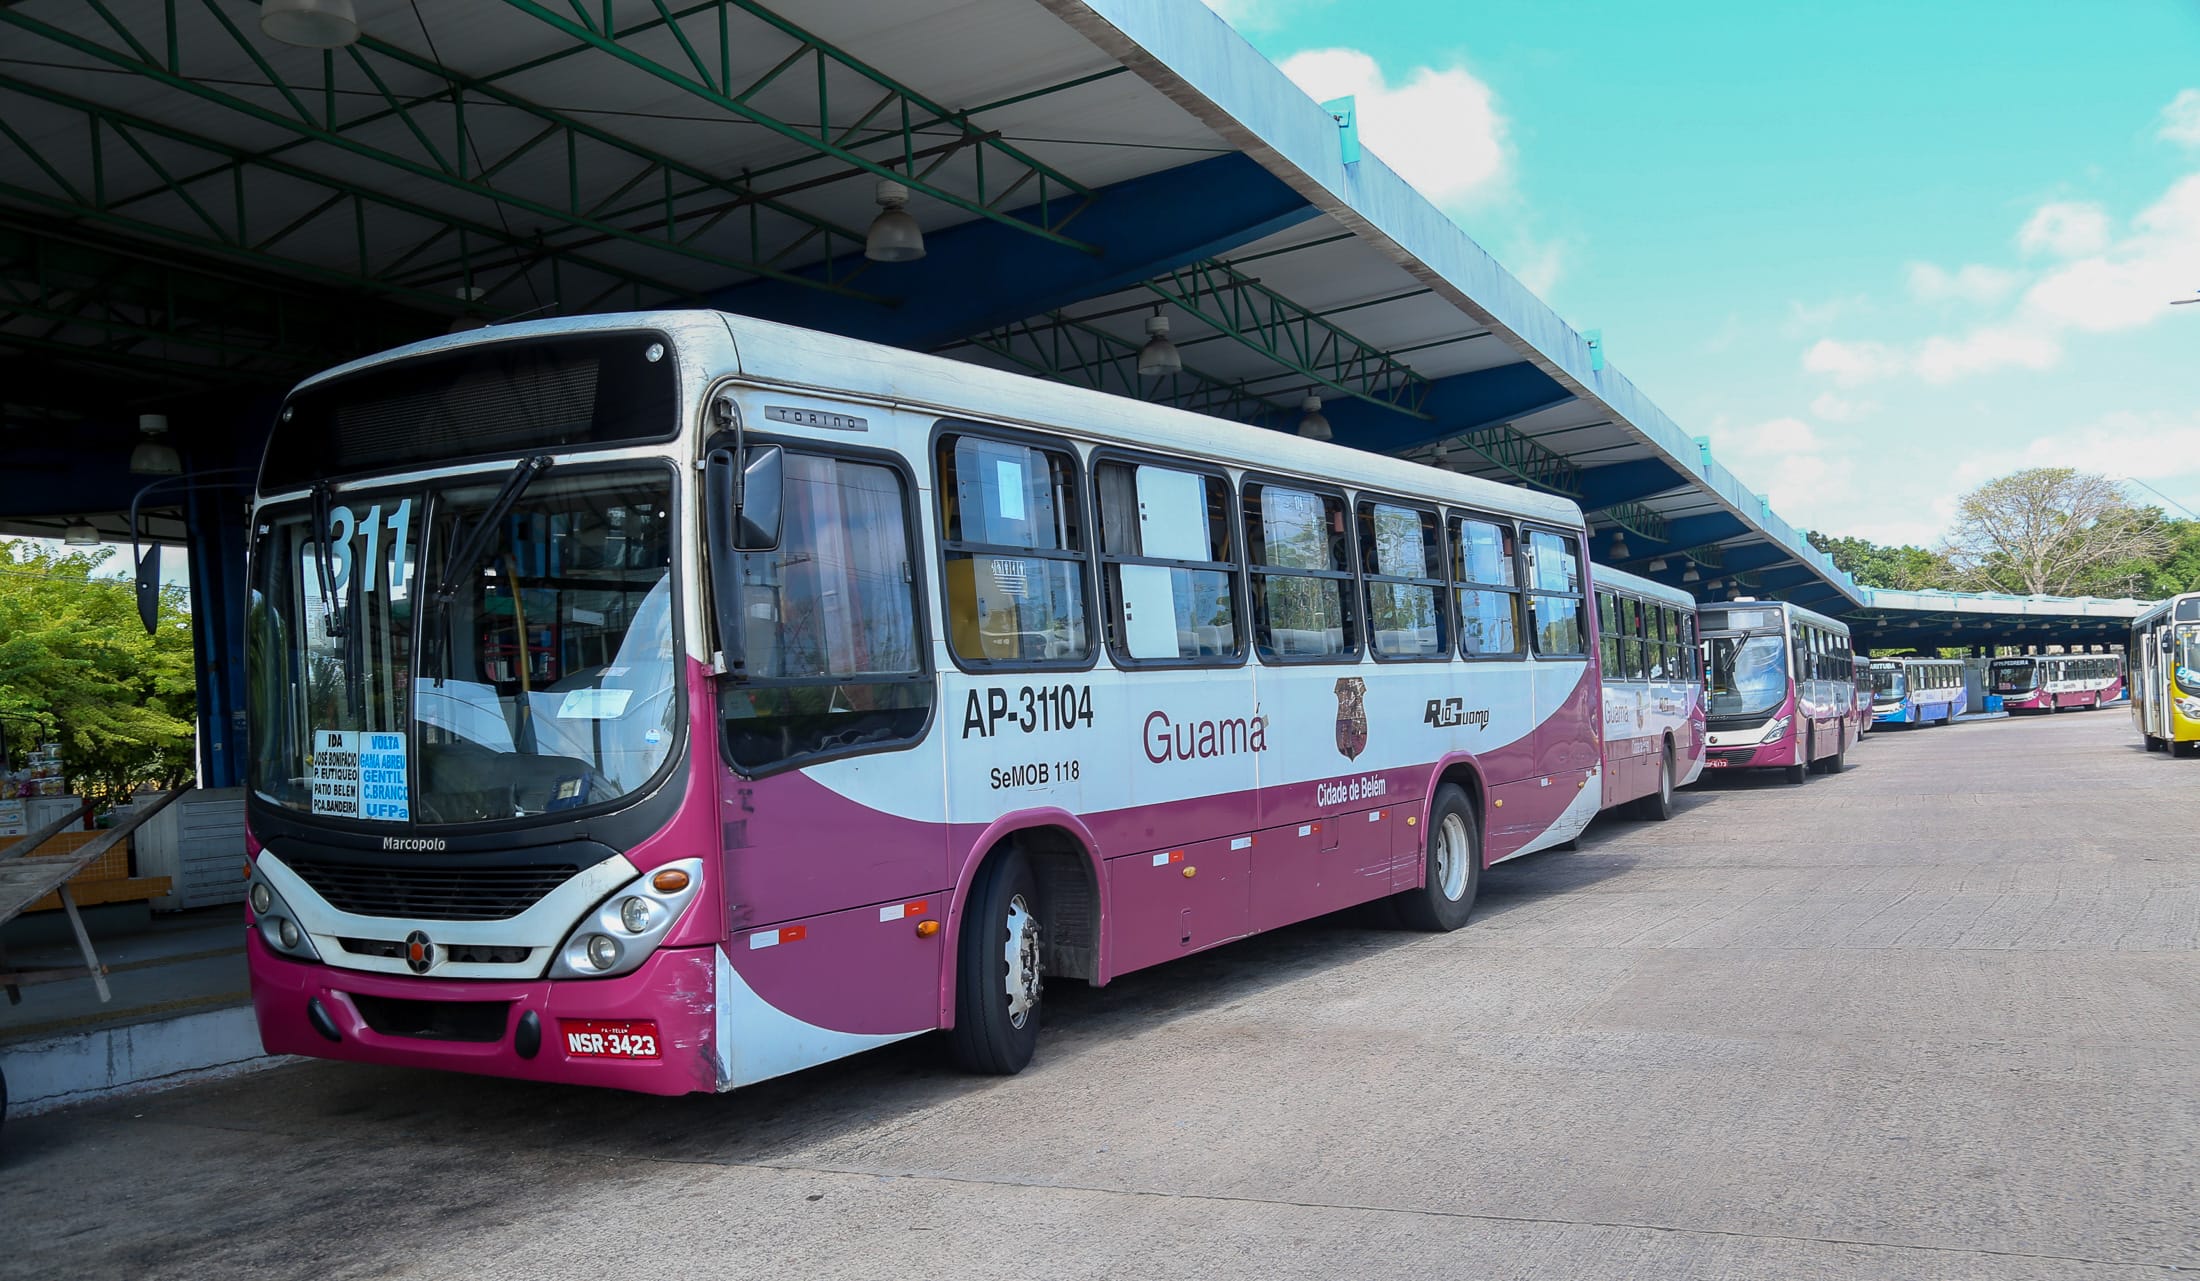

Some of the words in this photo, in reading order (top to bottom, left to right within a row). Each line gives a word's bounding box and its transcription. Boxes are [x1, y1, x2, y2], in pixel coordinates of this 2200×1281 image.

[780, 409, 856, 429] TORINO
[325, 498, 412, 591] 311
[962, 684, 1094, 739] AP-31104
[328, 733, 343, 748] IDA
[1142, 702, 1267, 764] Guamá
[371, 735, 400, 750] VOLTA
[360, 753, 381, 769] GAMA
[381, 754, 406, 770] ABREU
[321, 768, 358, 781] EUTIQUEO
[363, 770, 404, 784] GENTIL
[990, 763, 1050, 790] SeMOB
[1054, 760, 1080, 782] 118
[1317, 780, 1348, 808] Cidade
[1348, 778, 1360, 802] de
[1361, 774, 1386, 799] Belém
[366, 803, 408, 818] UFPa
[383, 836, 446, 852] Marcopolo
